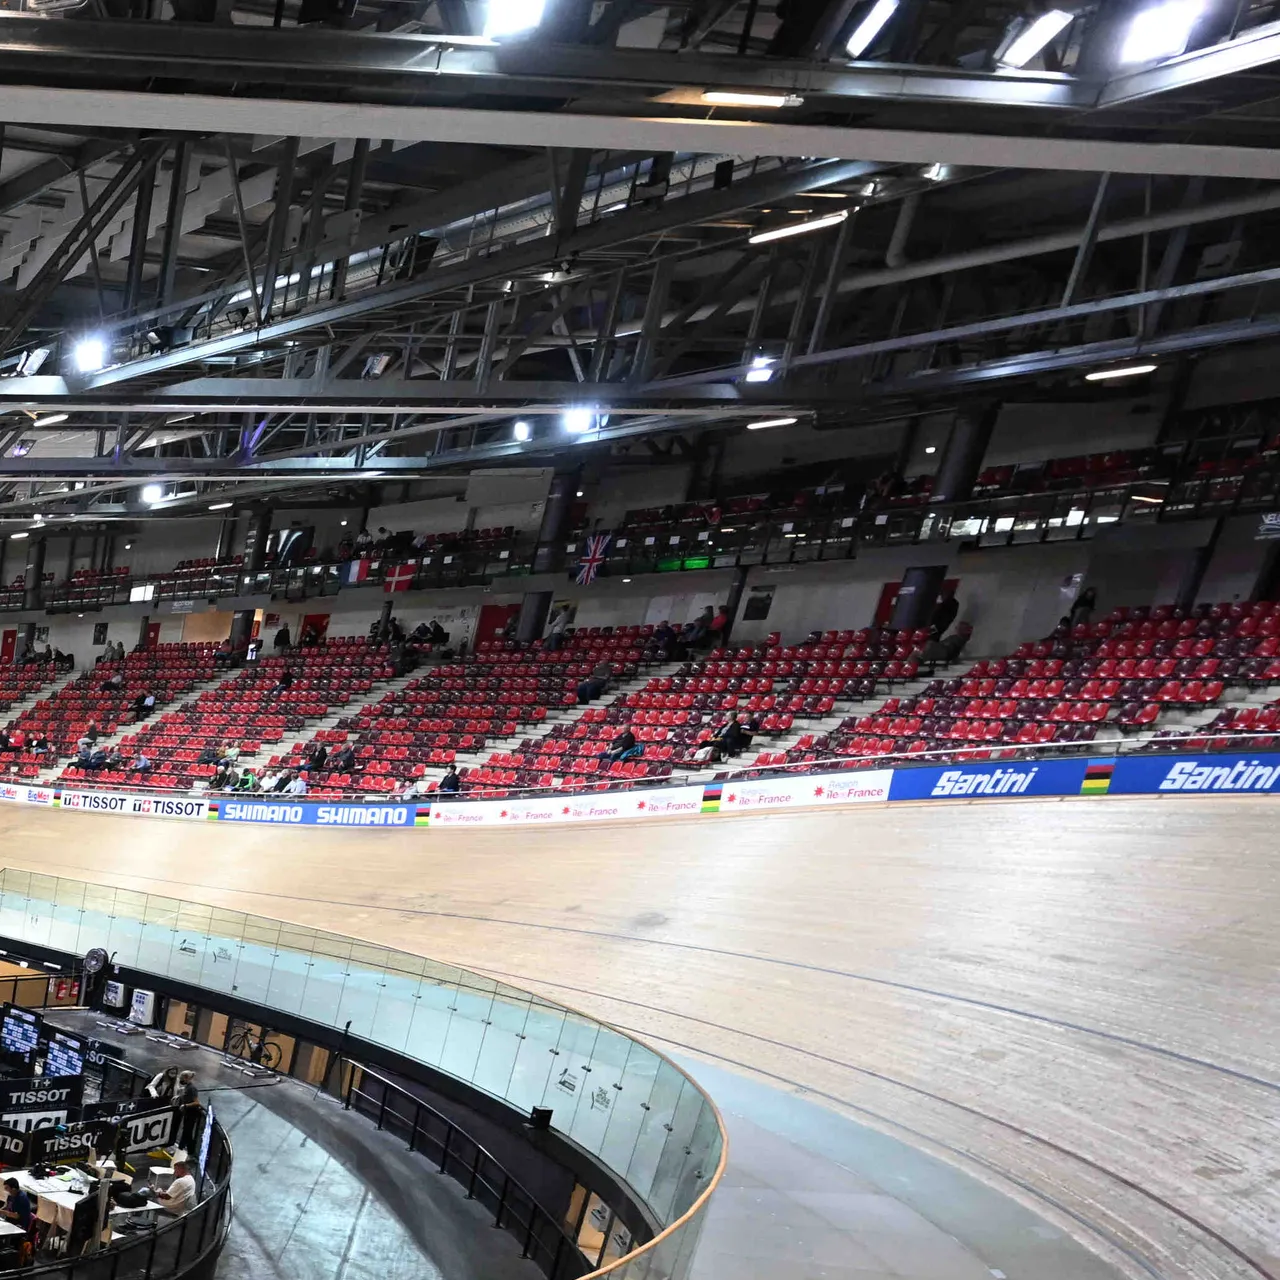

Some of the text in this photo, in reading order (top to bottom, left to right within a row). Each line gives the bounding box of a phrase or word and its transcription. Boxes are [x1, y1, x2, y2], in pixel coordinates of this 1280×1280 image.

[931, 767, 1039, 796] Santini
[27, 789, 49, 803] BigMat
[758, 794, 792, 804] France
[847, 786, 884, 798] France
[81, 796, 127, 811] TISSOT
[152, 799, 204, 817] TISSOT
[666, 801, 697, 811] France
[224, 804, 303, 824] SHIMANO
[316, 806, 408, 825] SHIMANO
[458, 814, 483, 822] France
[525, 811, 553, 820] France
[589, 807, 618, 816] France
[9, 1088, 71, 1105] TISSOT
[132, 1118, 167, 1145] UCI
